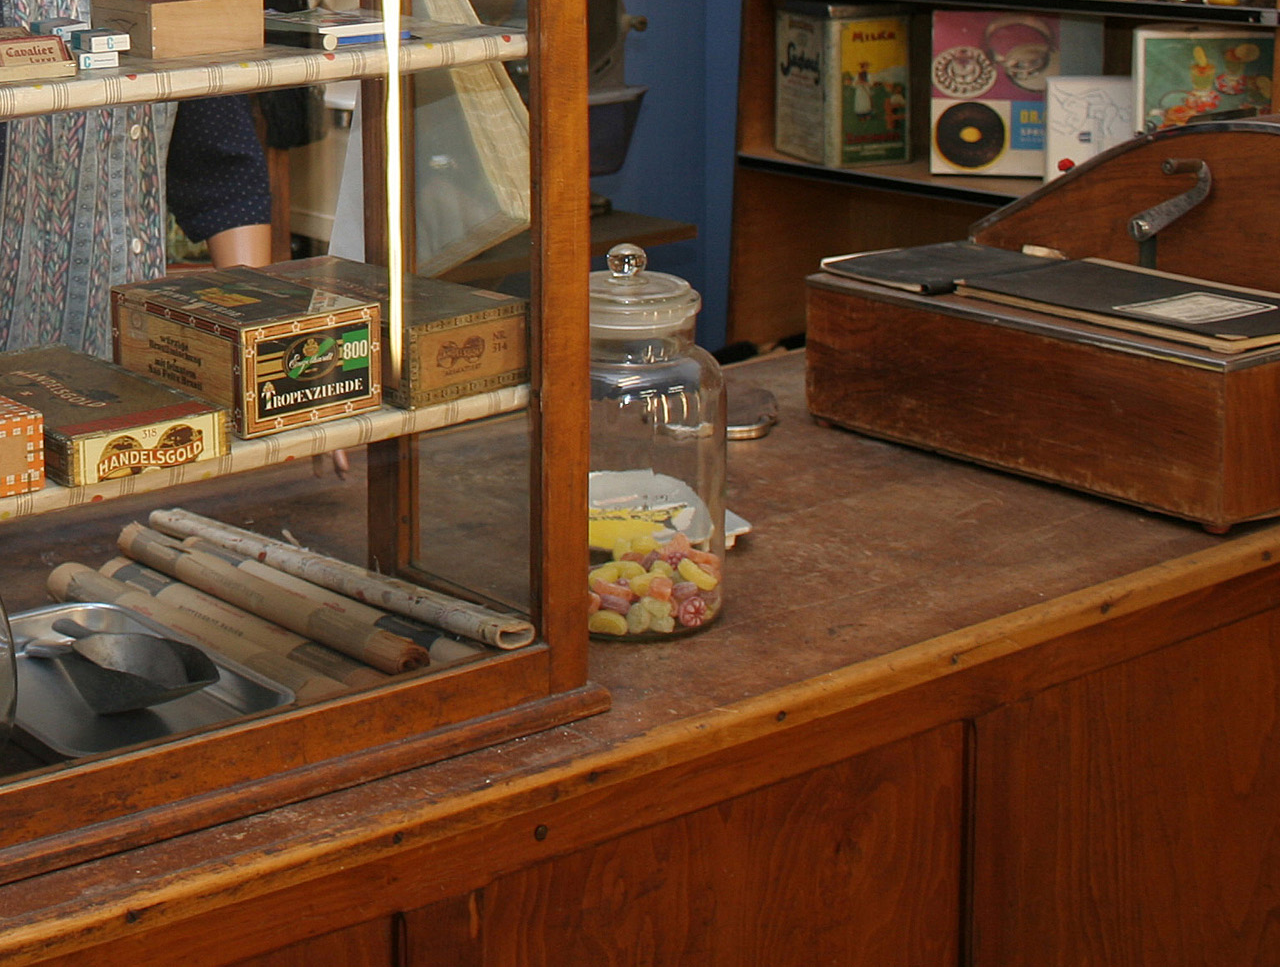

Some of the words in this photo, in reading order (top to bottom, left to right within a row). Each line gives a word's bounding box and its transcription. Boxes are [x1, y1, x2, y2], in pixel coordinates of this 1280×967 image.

[5, 45, 55, 59] Cavalier
[342, 339, 369, 360] 800
[261, 377, 364, 411] TROPENZIERDE
[99, 440, 203, 476] HANDELSGOLD
